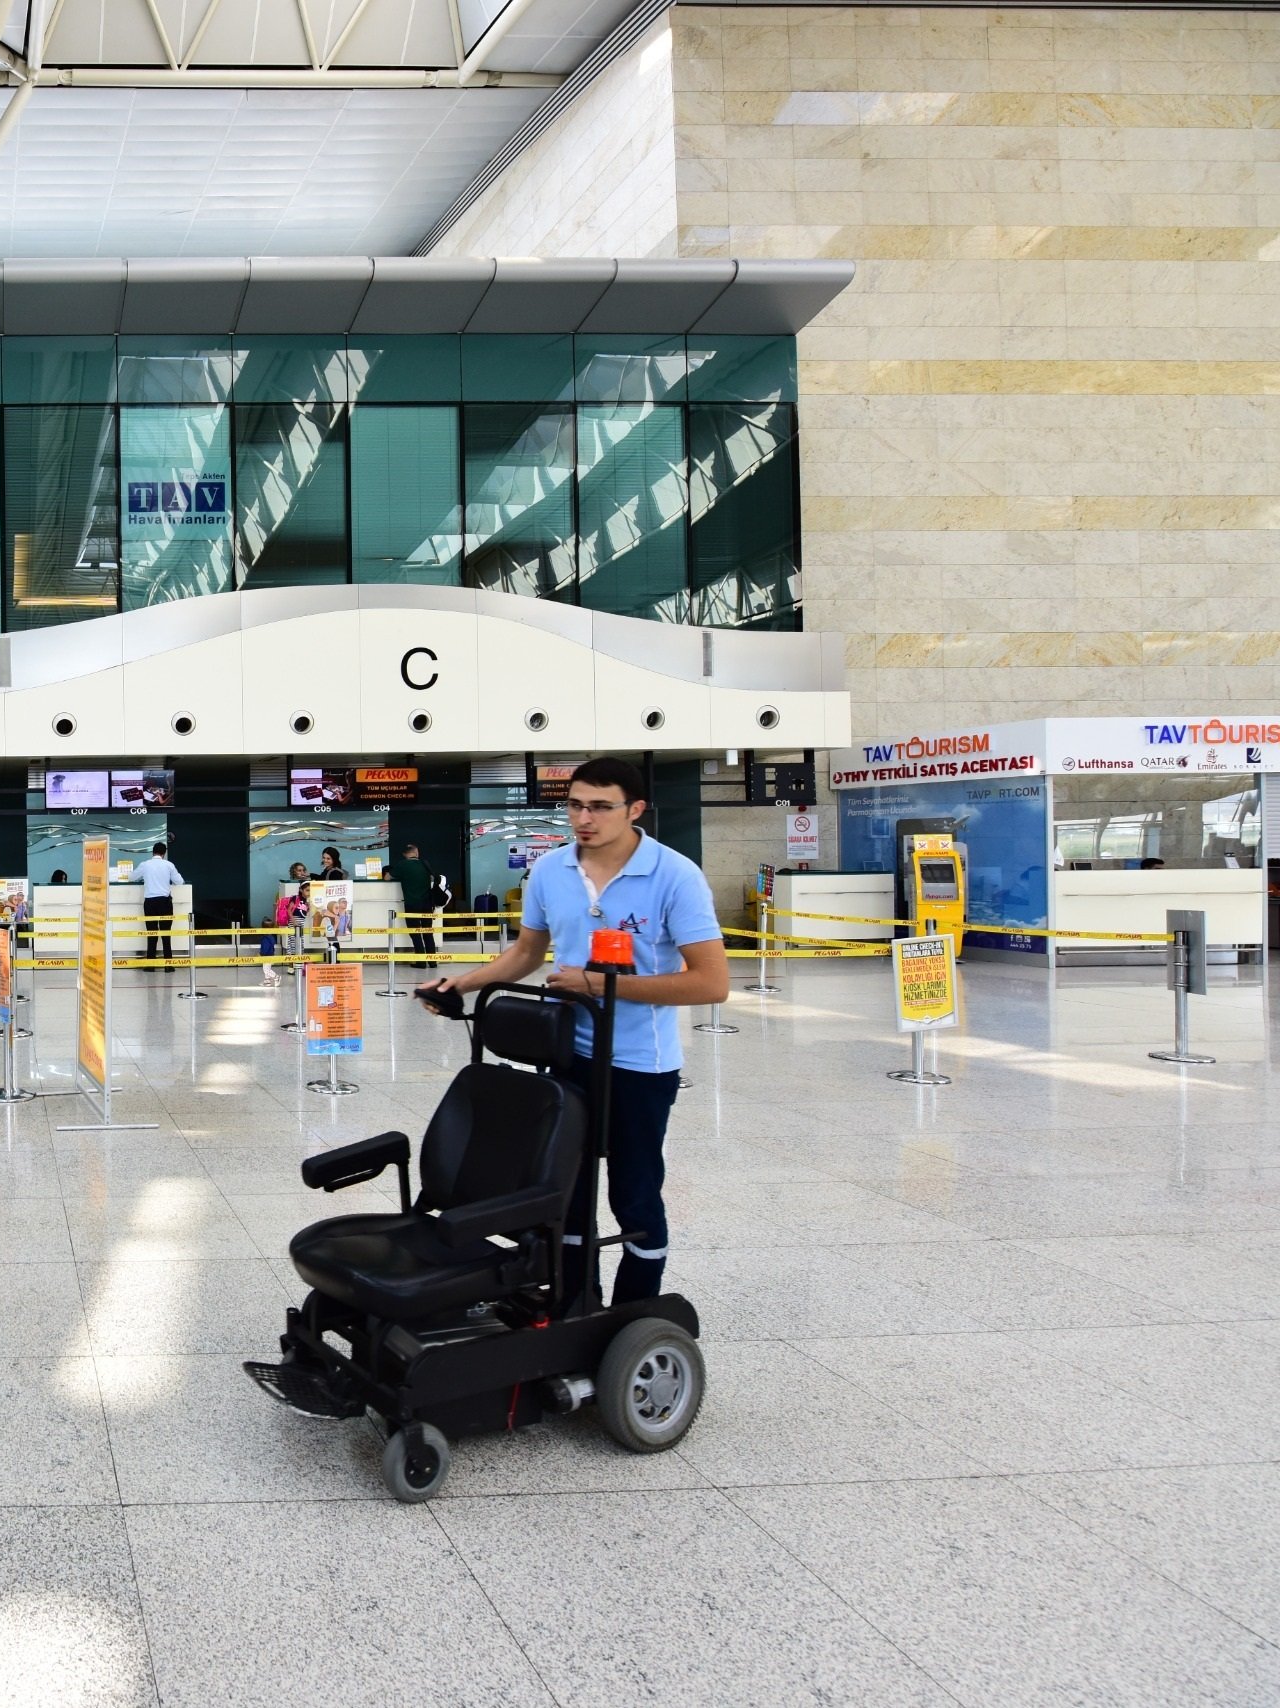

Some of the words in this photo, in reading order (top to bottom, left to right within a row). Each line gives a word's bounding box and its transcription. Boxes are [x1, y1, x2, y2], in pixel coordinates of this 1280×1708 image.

[130, 485, 222, 510] TAV
[128, 514, 225, 525] Havaimanları
[401, 647, 438, 690] C
[843, 770, 869, 783] THY
[872, 763, 918, 781] YETKİLİ
[920, 762, 958, 777] SATIŞ
[961, 755, 1034, 774] ACENTASI
[1078, 759, 1134, 769] Lufthansa
[1141, 756, 1175, 767] QATAR
[365, 769, 409, 780] PEGASUS
[847, 798, 861, 806] Tüm
